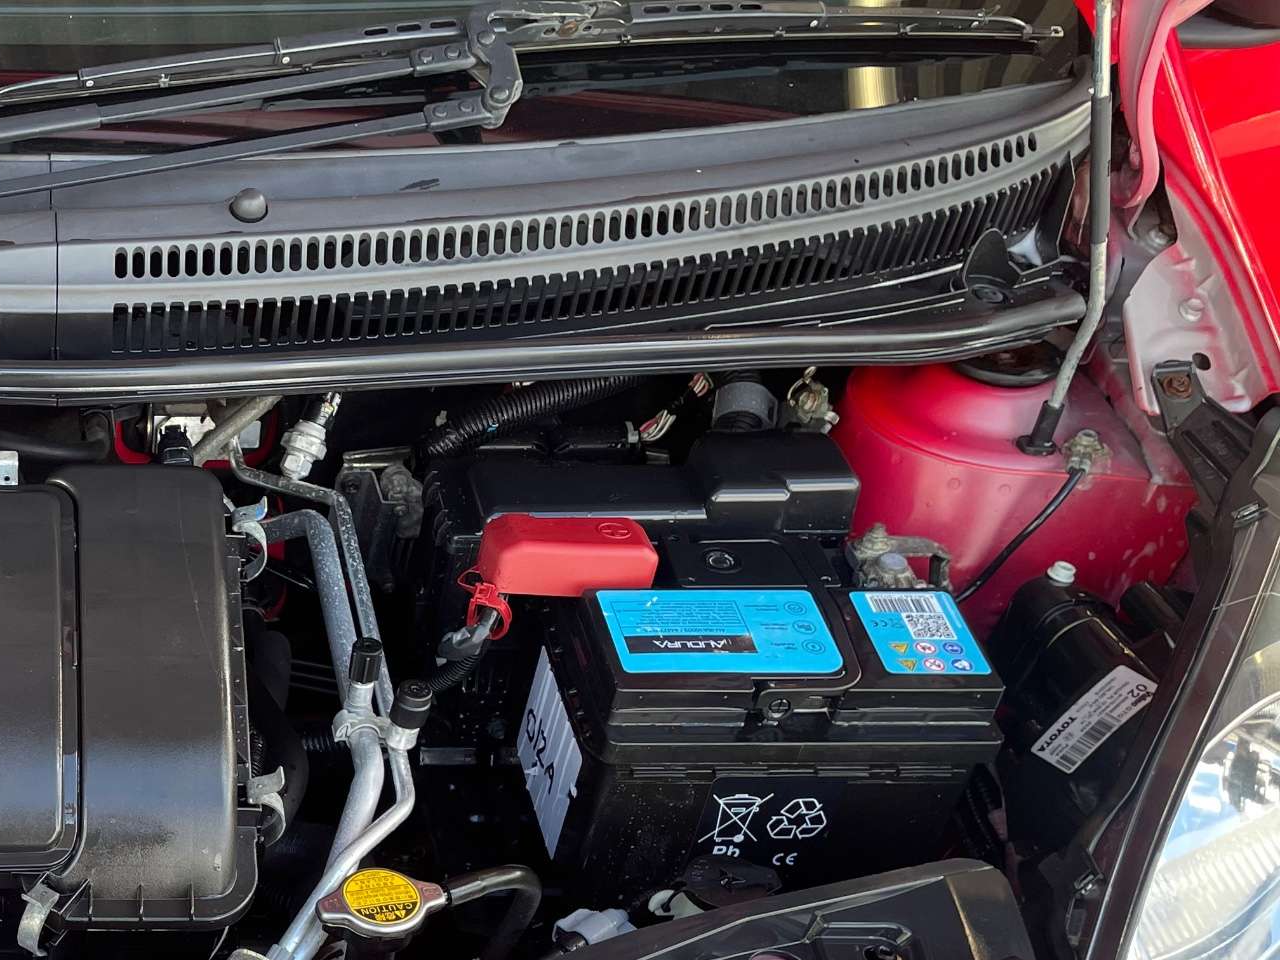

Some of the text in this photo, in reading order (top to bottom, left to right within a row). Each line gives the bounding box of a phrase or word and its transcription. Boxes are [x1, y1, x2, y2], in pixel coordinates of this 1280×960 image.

[1129, 683, 1147, 698] 02
[1037, 715, 1078, 752] TOYOTA
[360, 903, 412, 916] CAUTION
